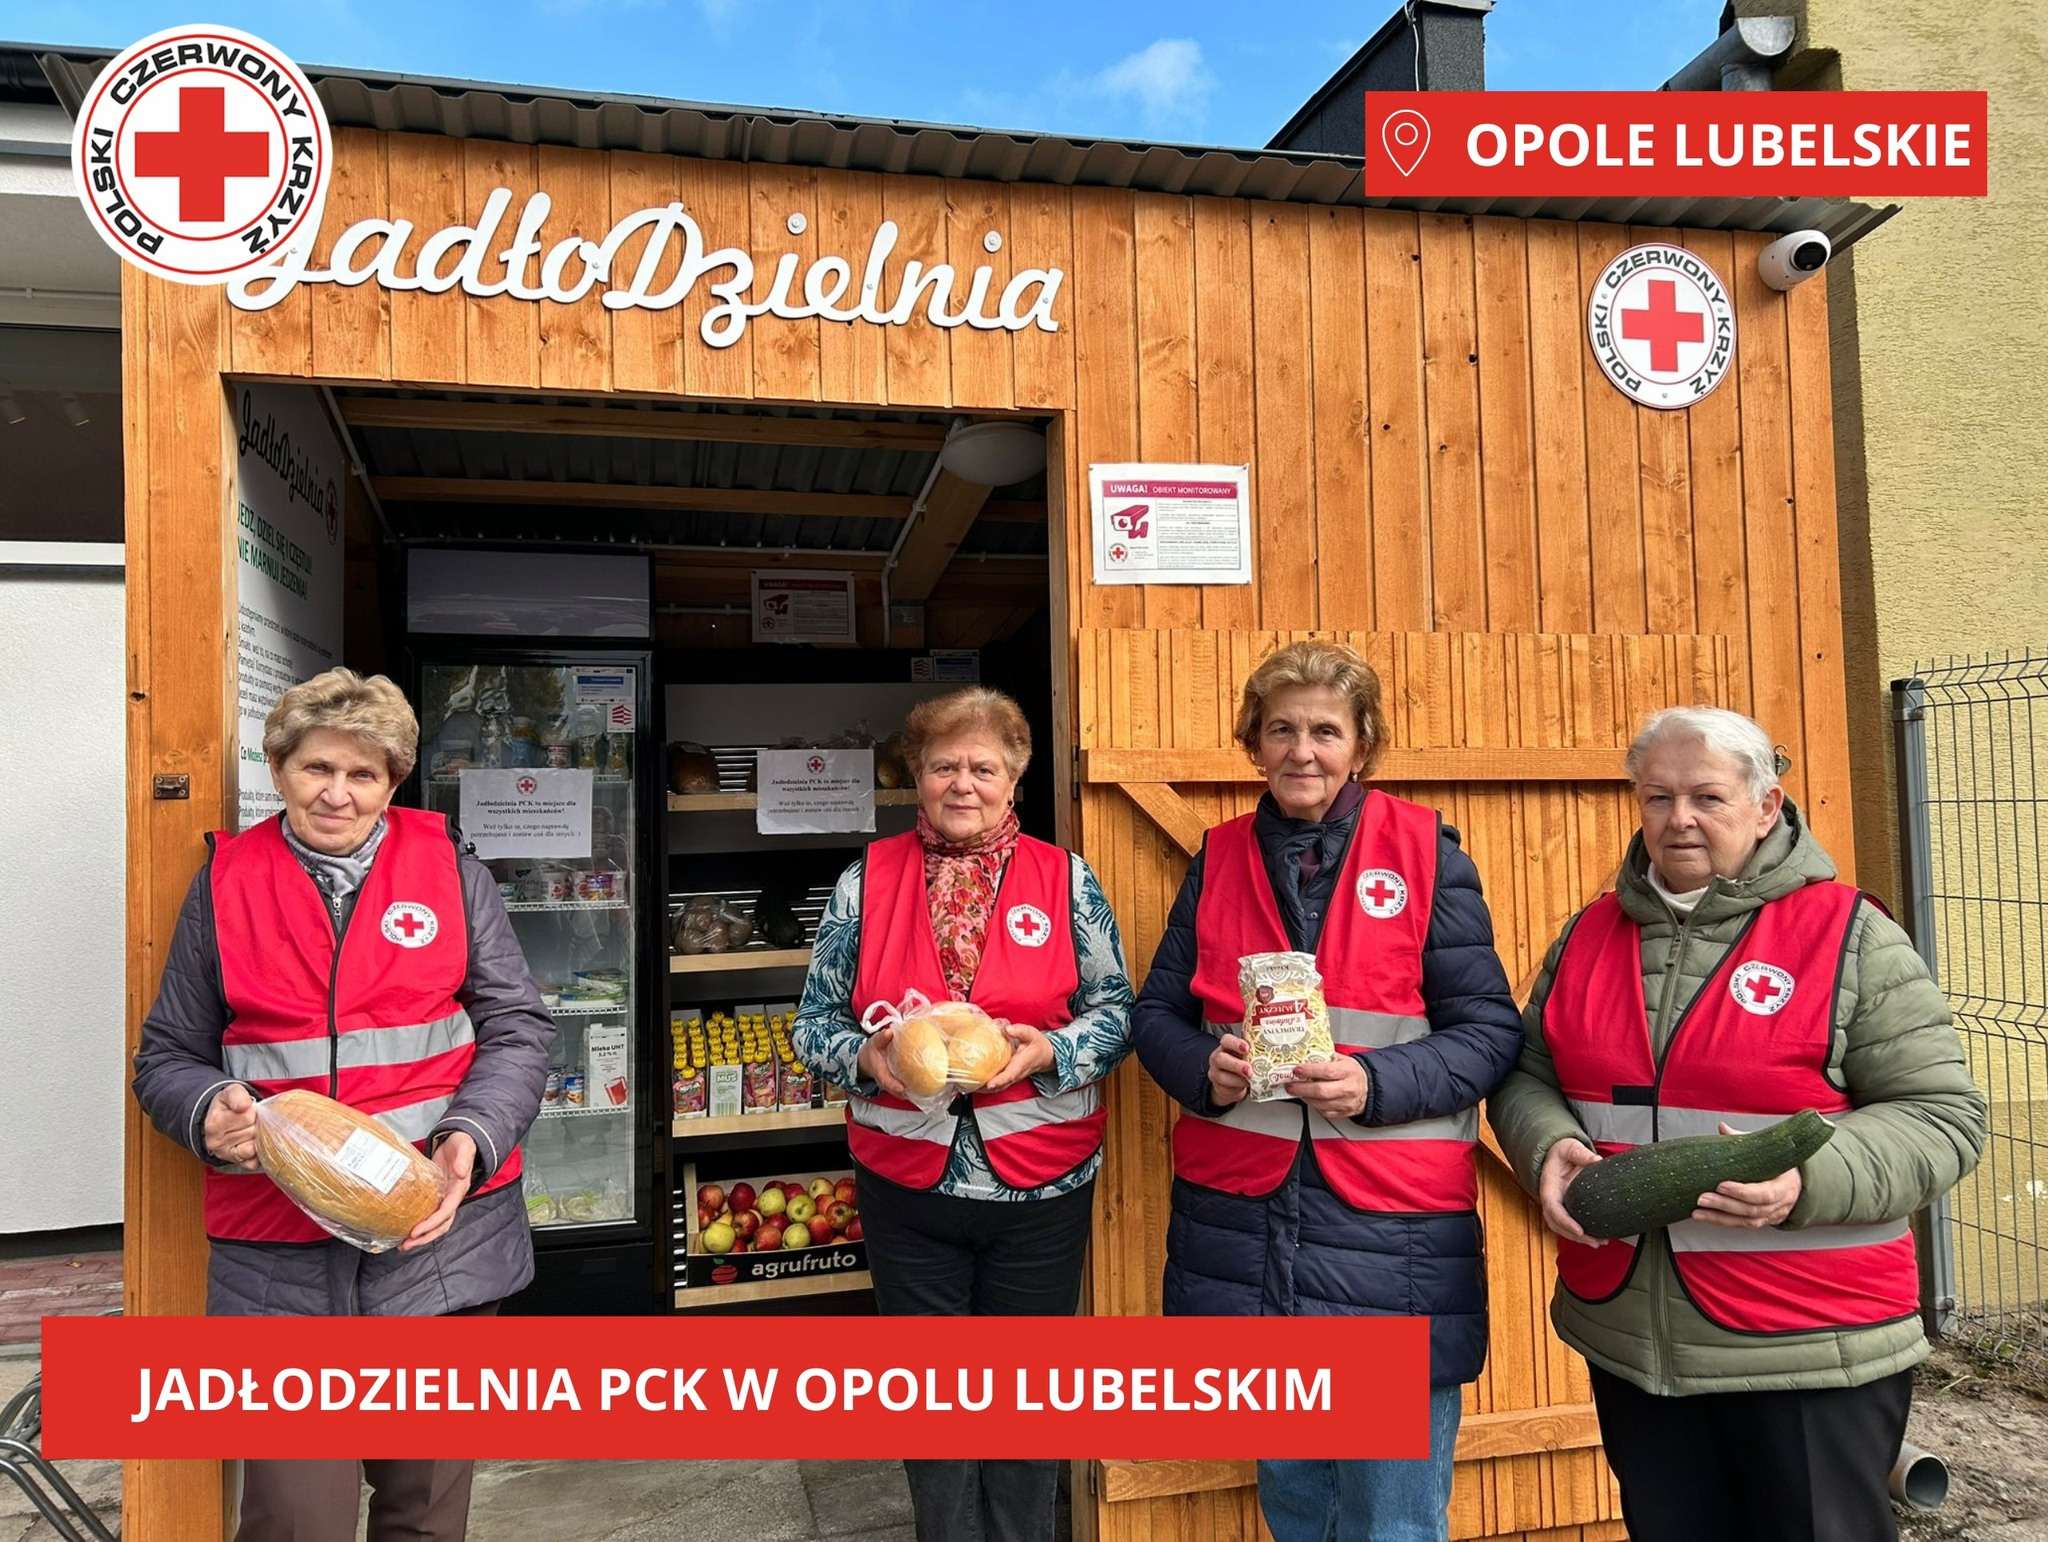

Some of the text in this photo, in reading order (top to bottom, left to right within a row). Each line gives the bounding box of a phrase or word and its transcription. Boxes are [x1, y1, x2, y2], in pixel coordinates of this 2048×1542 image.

[1594, 249, 1732, 396] POLSKI CZERWONY KRZYŻ
[1110, 484, 1232, 496] UWAGA! OBIEKT MONITOROWANY
[519, 799, 534, 807] PCK
[751, 1250, 857, 1279] agrufruto
